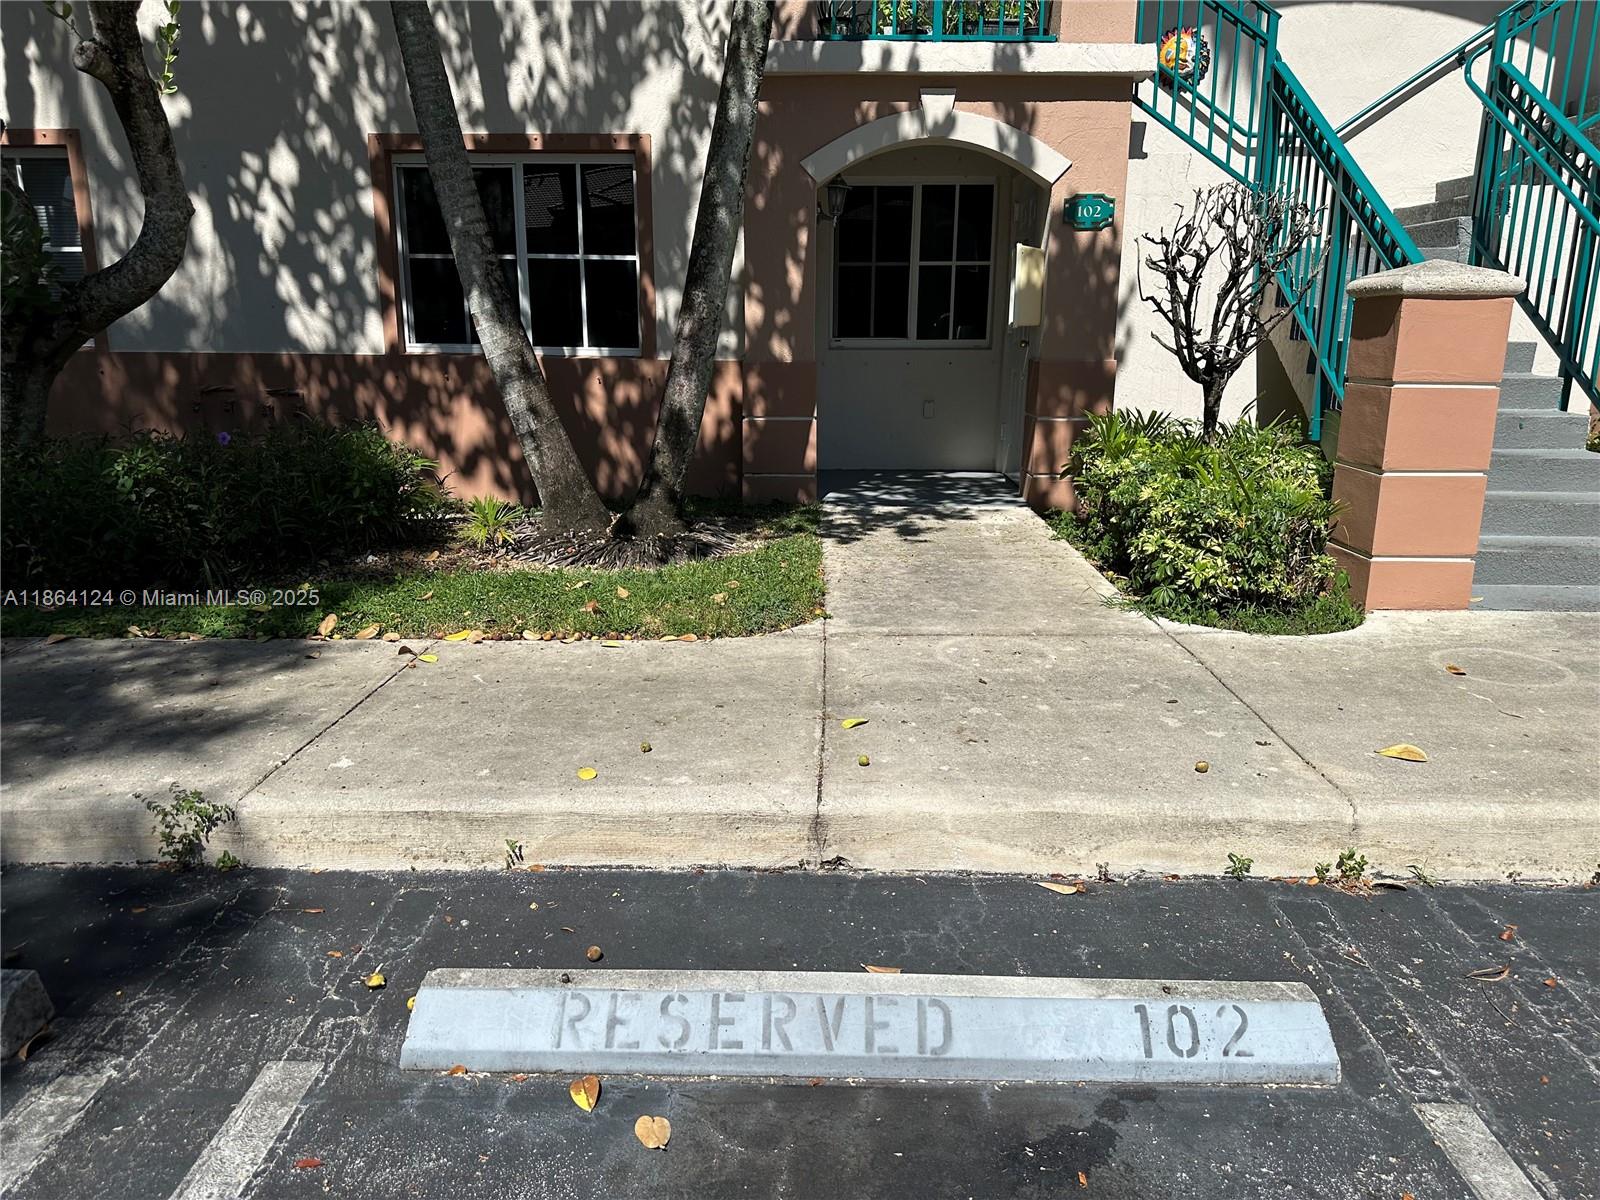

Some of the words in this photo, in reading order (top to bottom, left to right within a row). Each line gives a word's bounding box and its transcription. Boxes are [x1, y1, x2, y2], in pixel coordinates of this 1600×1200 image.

[1077, 205, 1102, 218] 102
[552, 991, 953, 1056] RESERVED
[1134, 1004, 1255, 1059] 102
